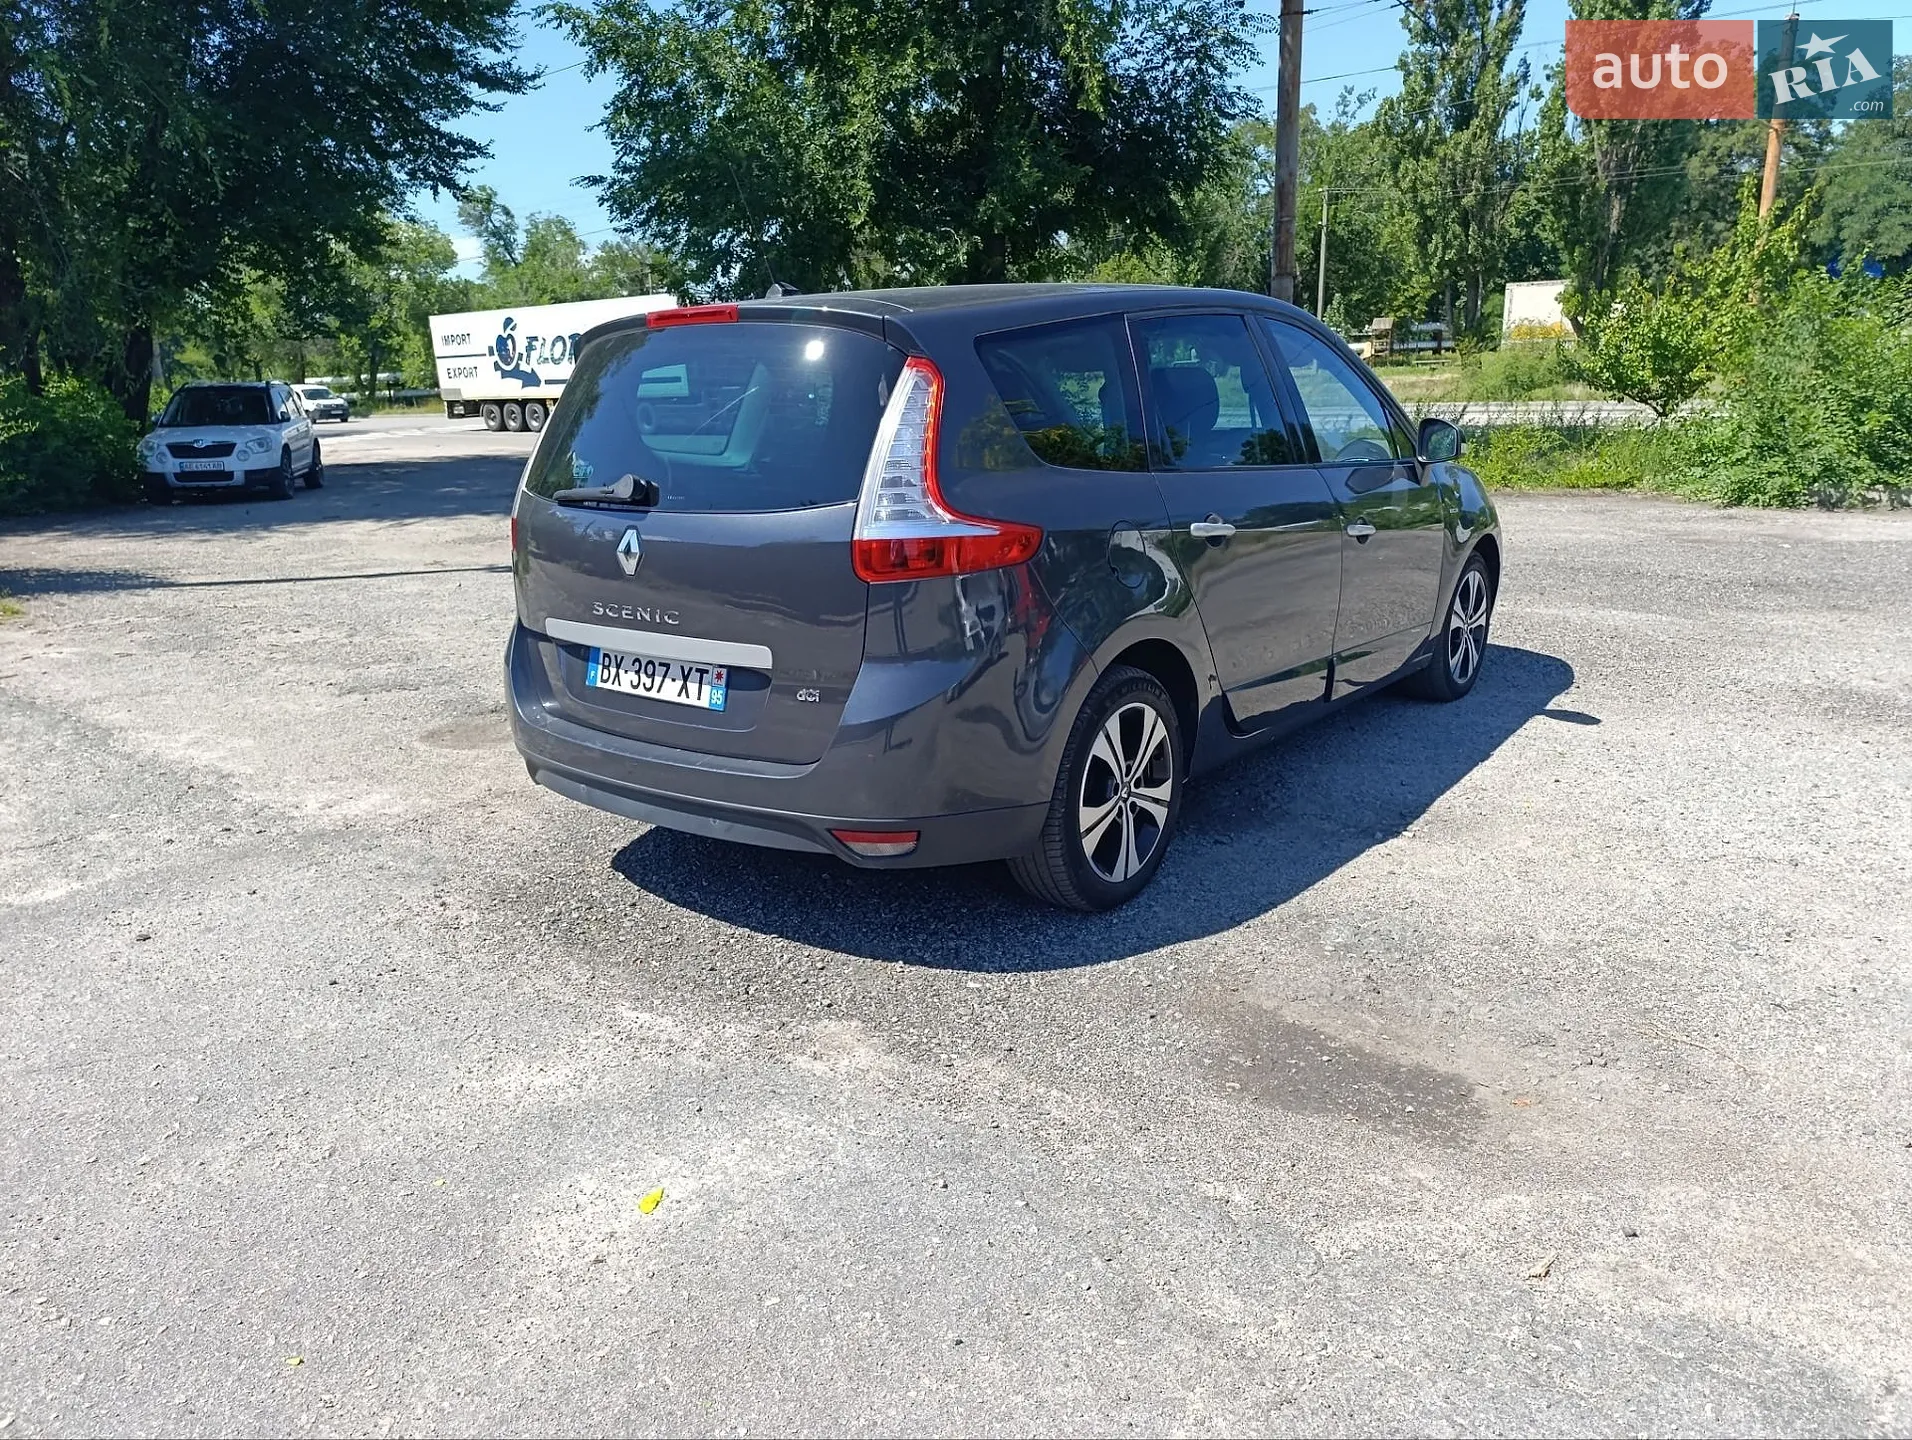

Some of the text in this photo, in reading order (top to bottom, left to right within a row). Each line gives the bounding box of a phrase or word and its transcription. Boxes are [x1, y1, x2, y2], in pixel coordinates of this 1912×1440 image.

[441, 333, 471, 346] IMPORT
[446, 366, 478, 379] EXPORT
[592, 601, 680, 625] SCENIC
[600, 652, 709, 701] BX-397-XT
[710, 689, 723, 705] 95
